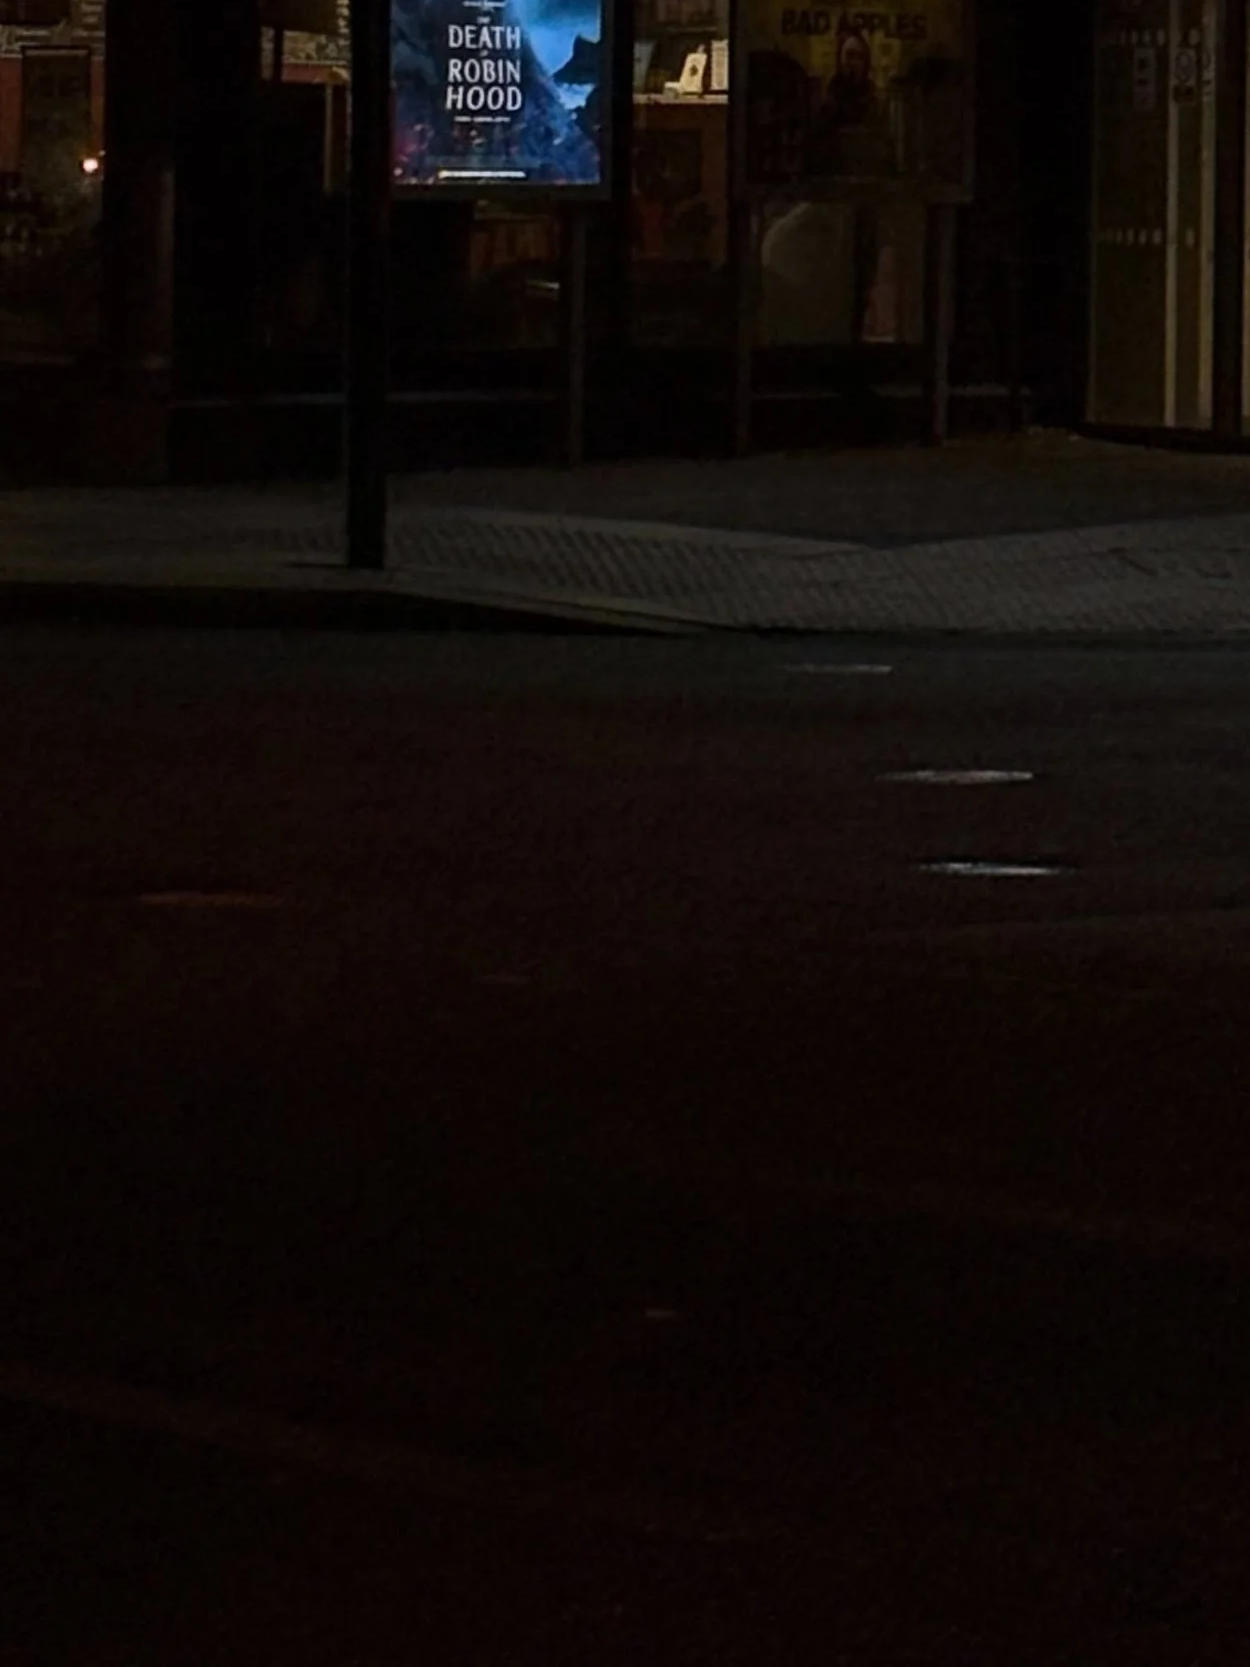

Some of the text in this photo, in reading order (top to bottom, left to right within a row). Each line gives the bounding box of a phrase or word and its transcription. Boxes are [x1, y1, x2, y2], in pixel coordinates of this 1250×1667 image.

[782, 7, 830, 38] BAD
[448, 24, 521, 50] DEATH
[447, 58, 521, 84] ROBIN
[445, 86, 522, 111] HOOD
